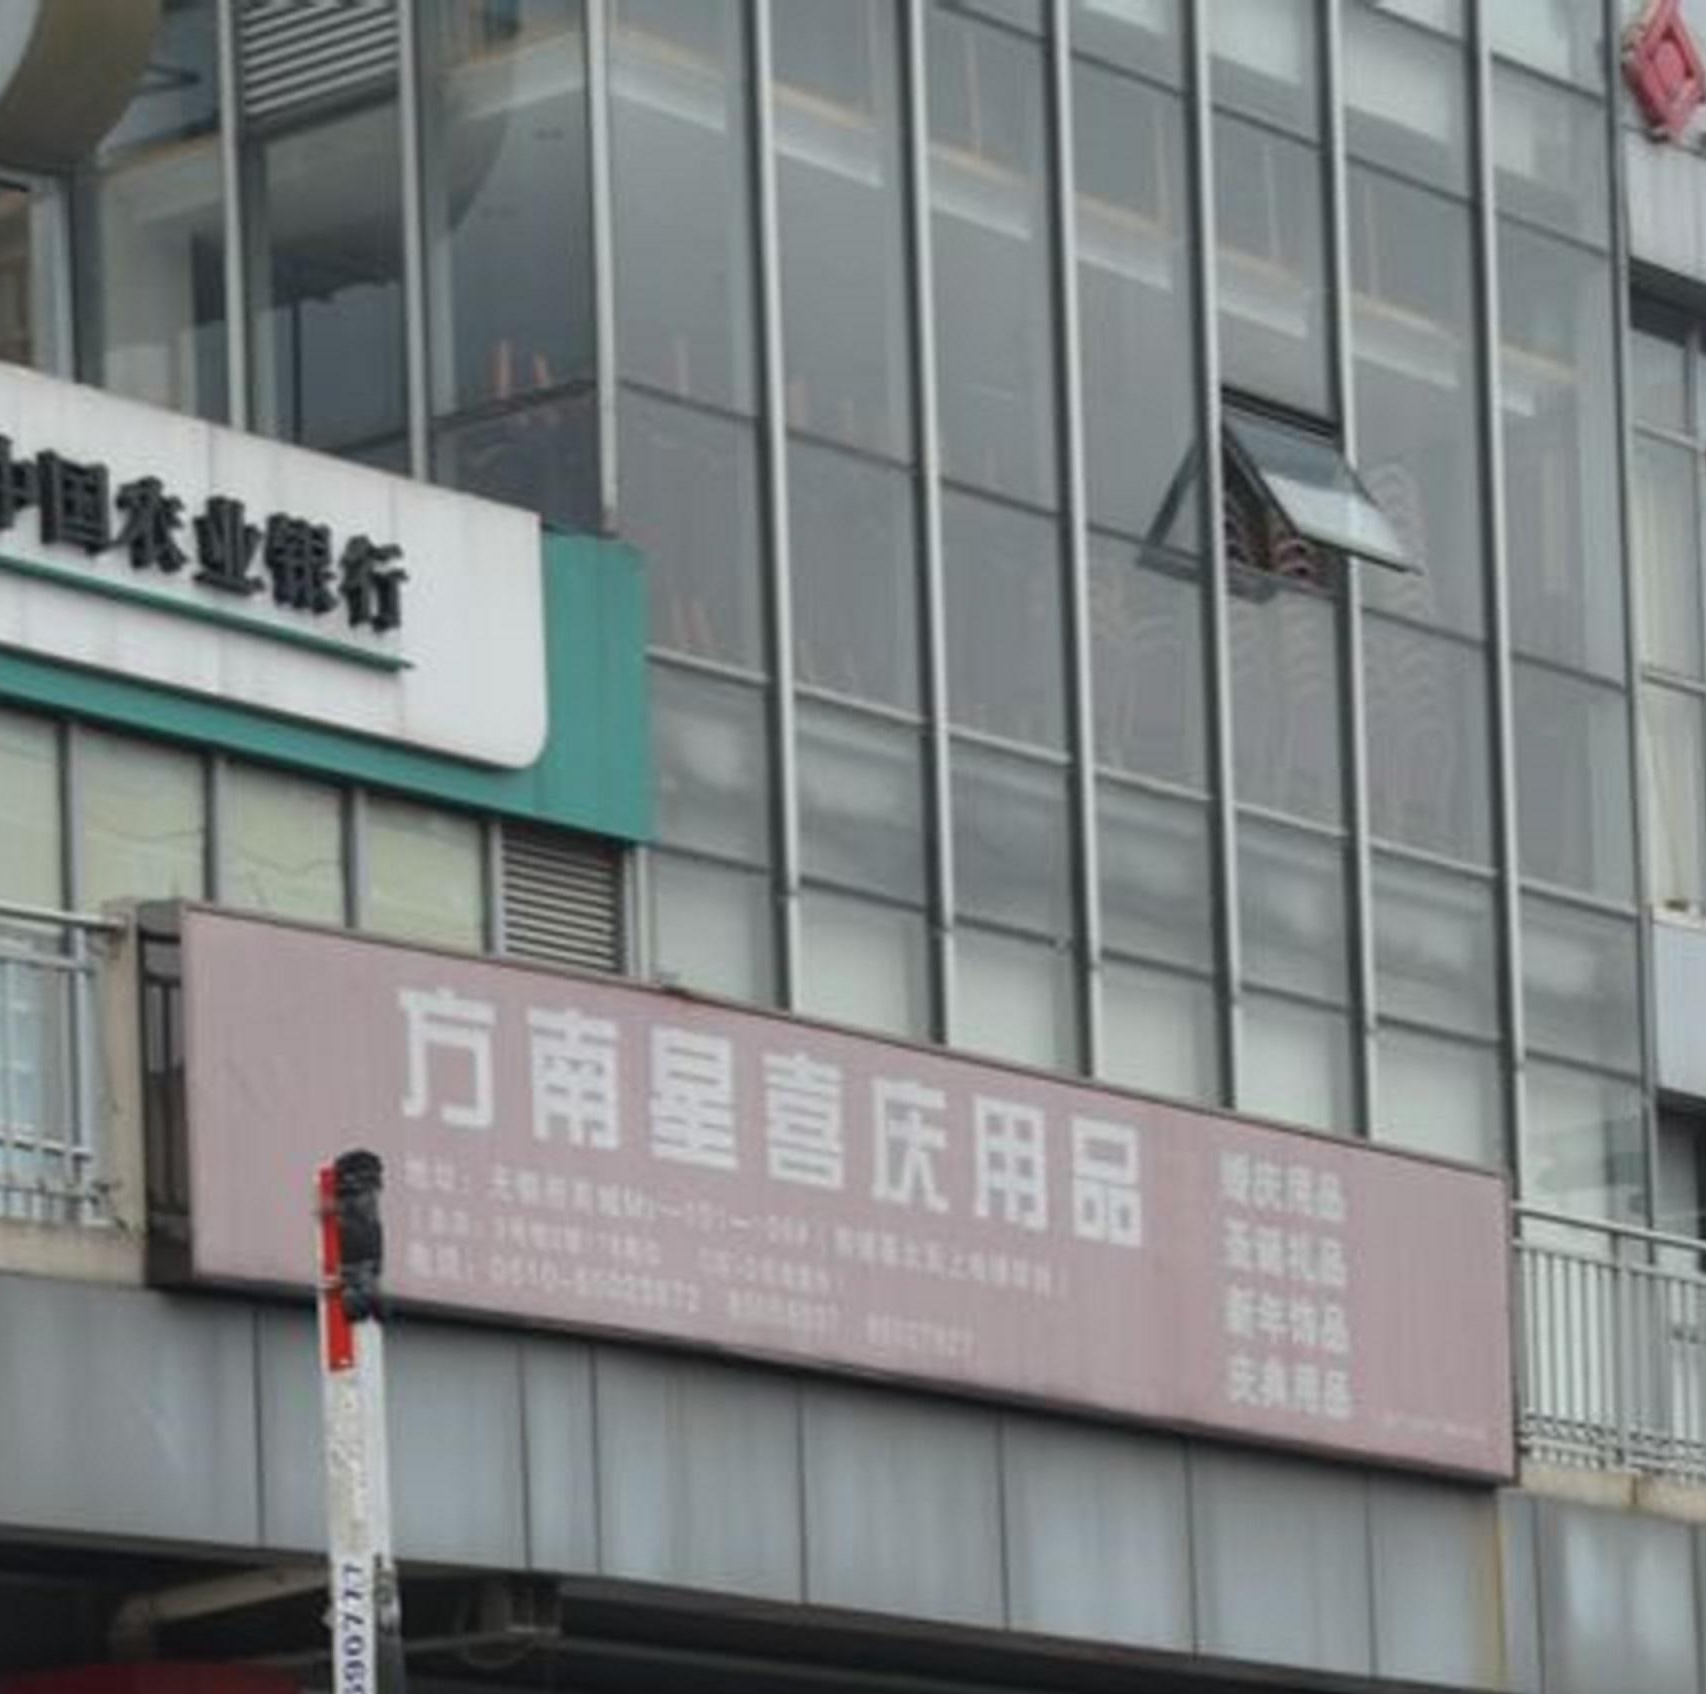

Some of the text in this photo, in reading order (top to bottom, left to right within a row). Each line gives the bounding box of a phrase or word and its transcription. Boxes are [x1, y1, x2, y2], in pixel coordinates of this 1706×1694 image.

[398, 987, 1144, 1249] 方南星喜庆用品
